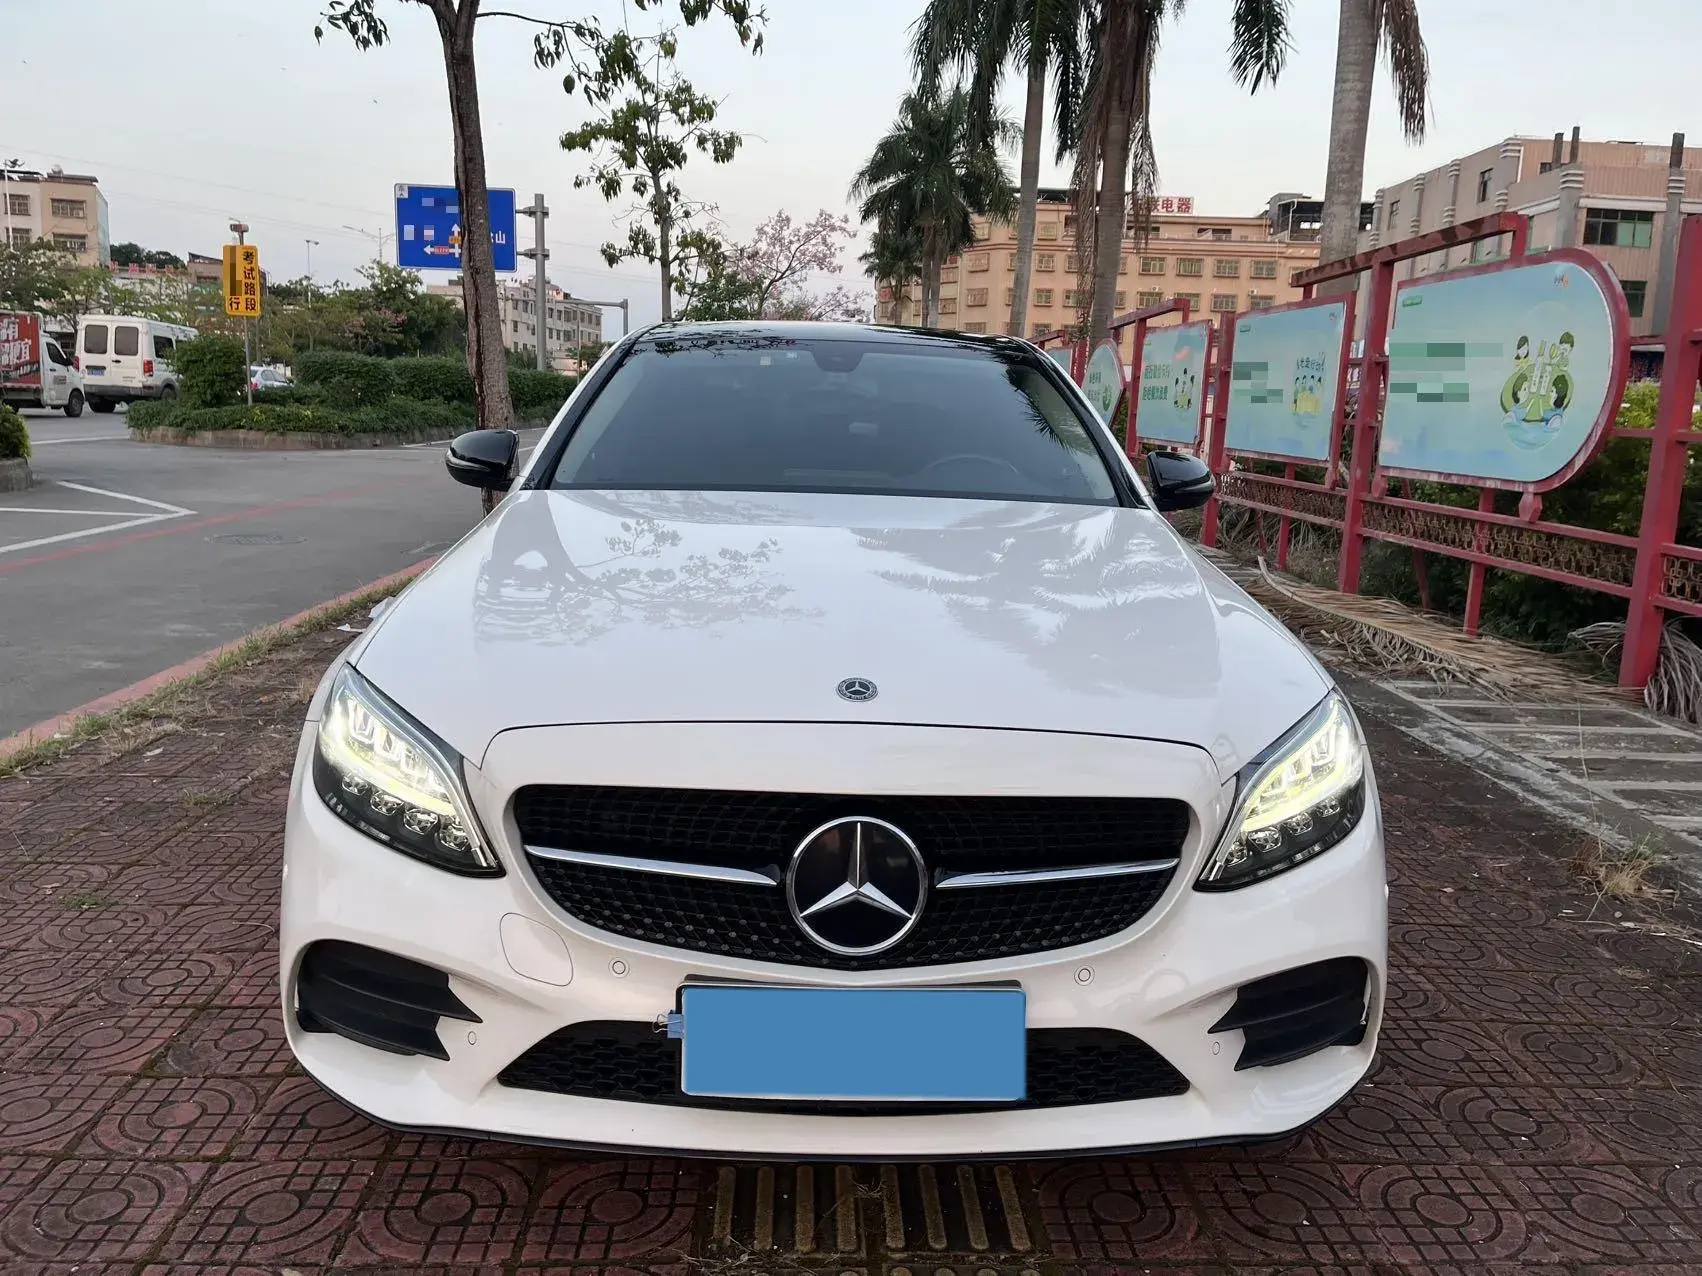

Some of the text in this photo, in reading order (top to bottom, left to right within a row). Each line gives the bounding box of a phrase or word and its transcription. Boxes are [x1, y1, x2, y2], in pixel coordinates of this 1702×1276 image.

[490, 230, 506, 245] 山
[243, 250, 257, 312] 考试路段
